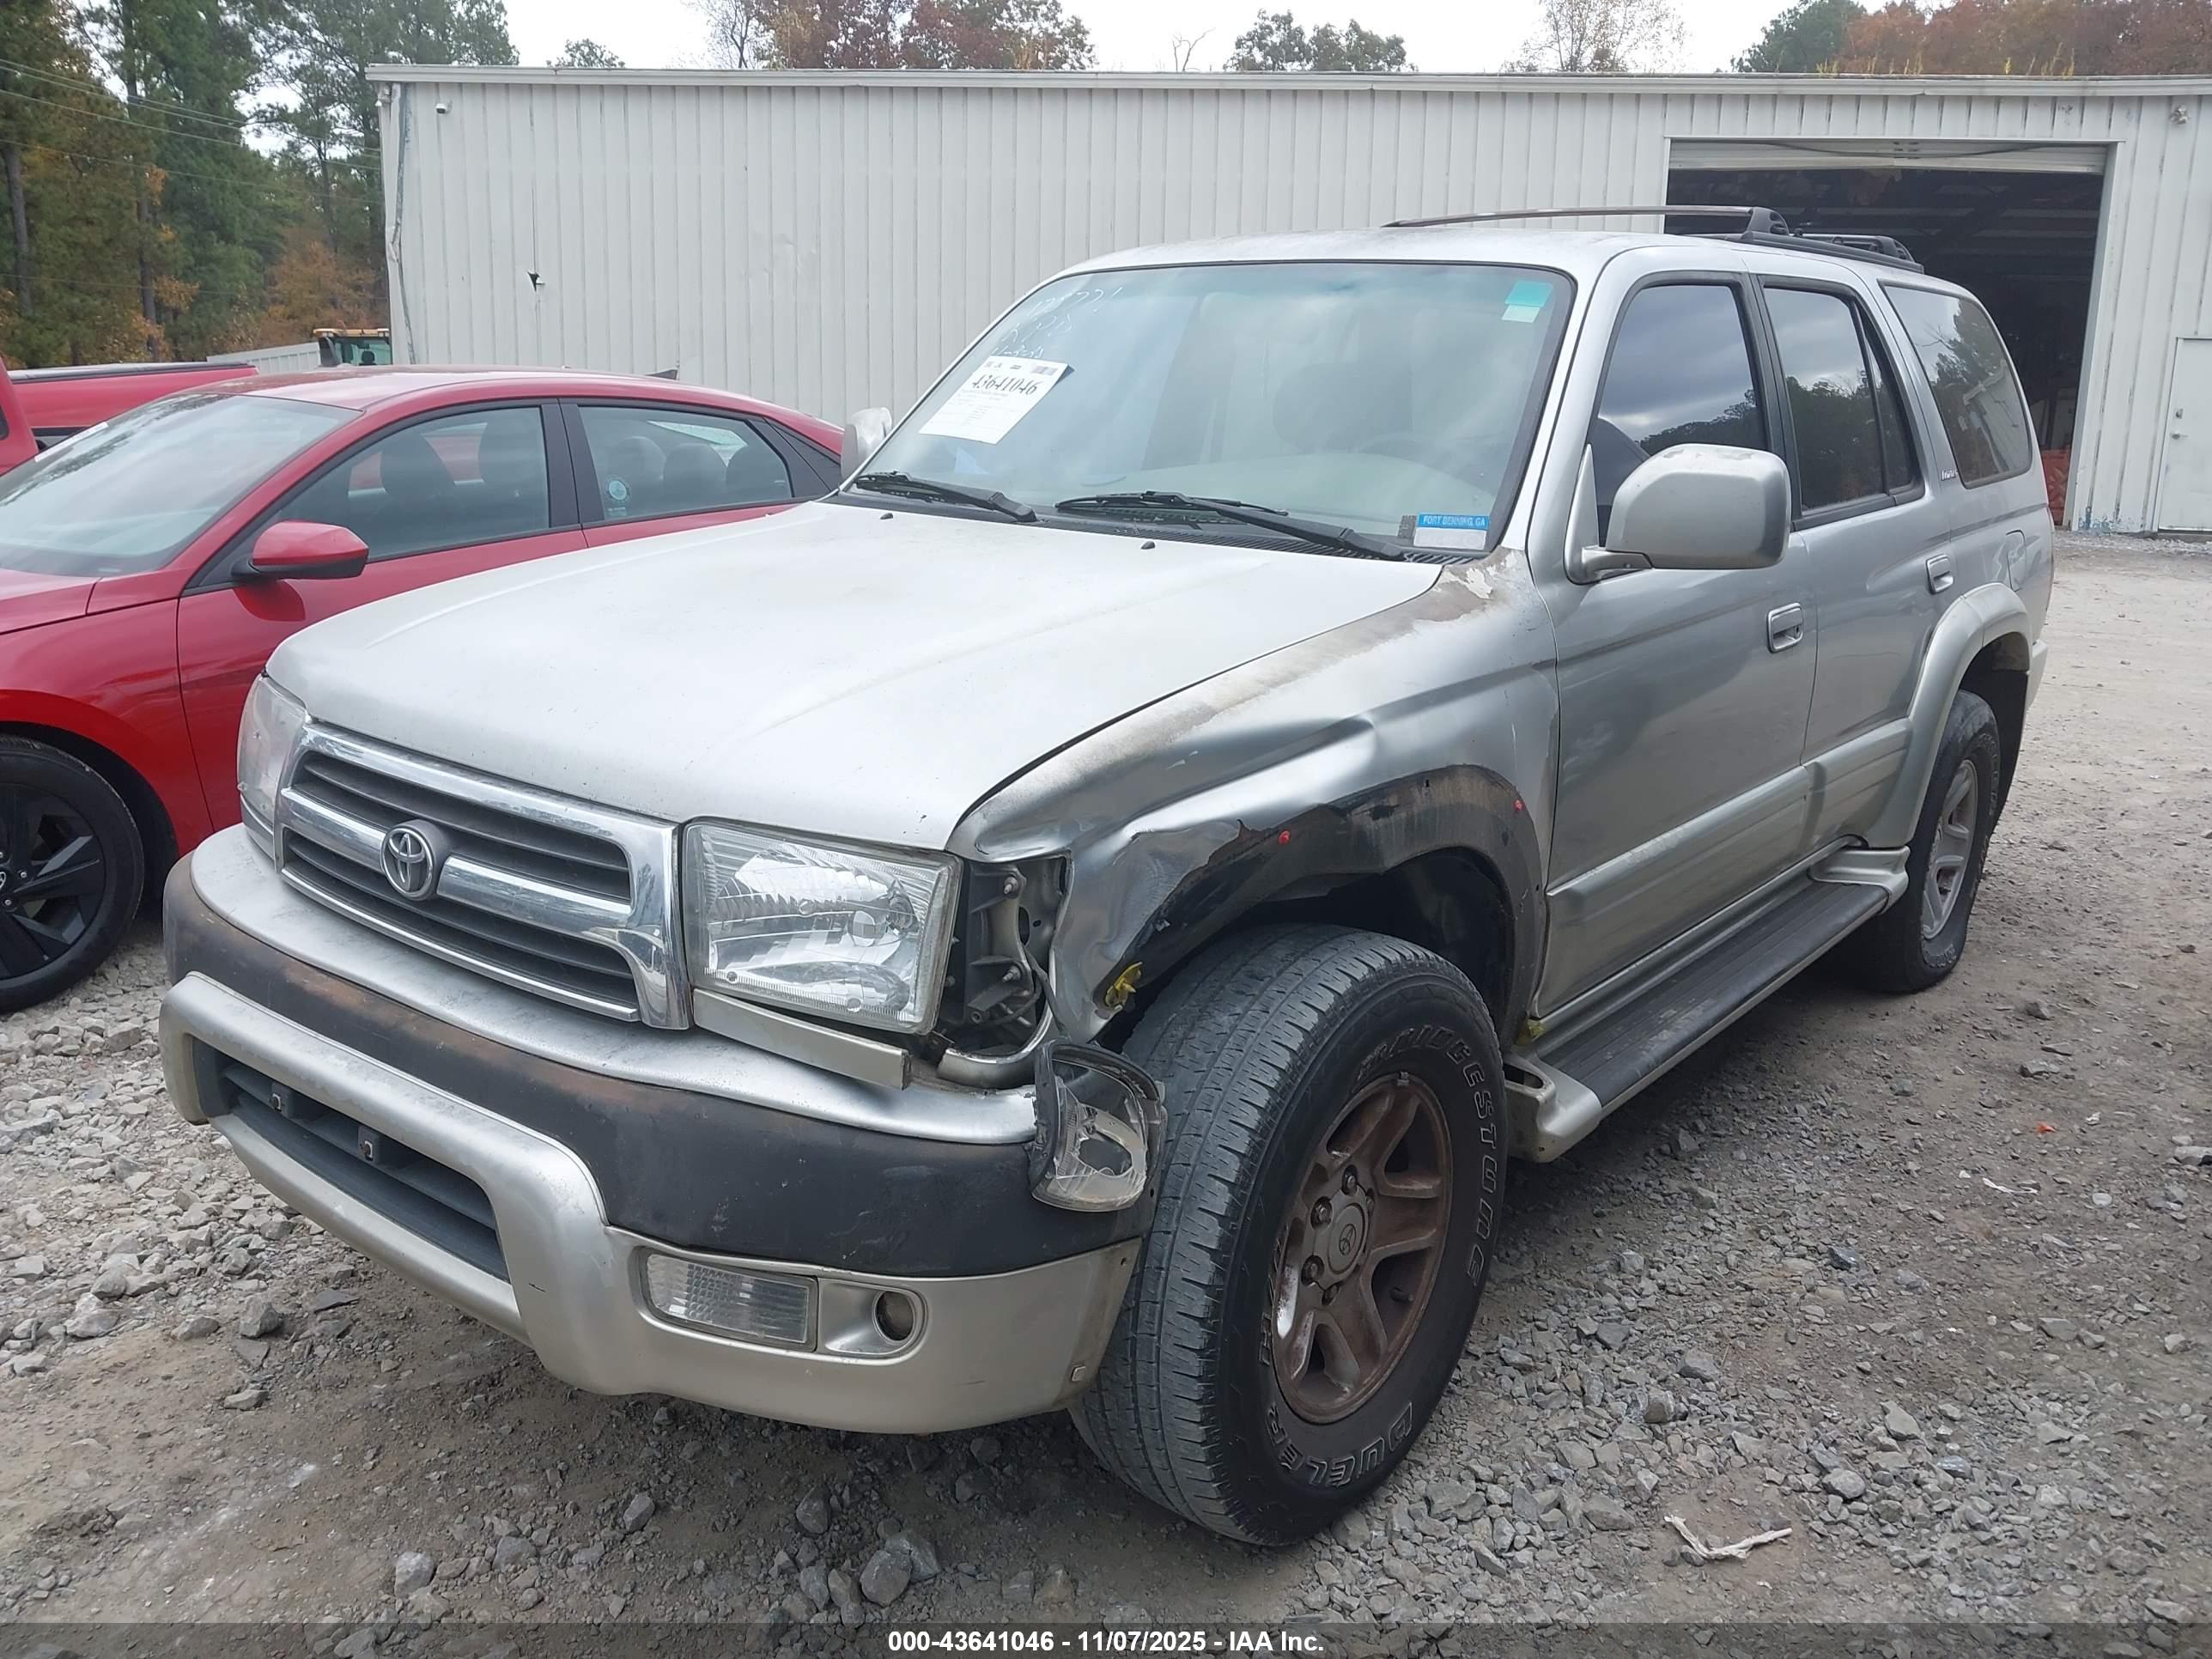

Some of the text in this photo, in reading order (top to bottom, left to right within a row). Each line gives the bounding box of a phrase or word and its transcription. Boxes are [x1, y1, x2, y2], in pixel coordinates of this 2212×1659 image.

[972, 374, 1045, 396] 43641046
[1423, 515, 1442, 525] FORT
[1474, 517, 1486, 526] GA
[1356, 1024, 1499, 1288] BRIDGESTONE
[1264, 1401, 1414, 1489] DUELER
